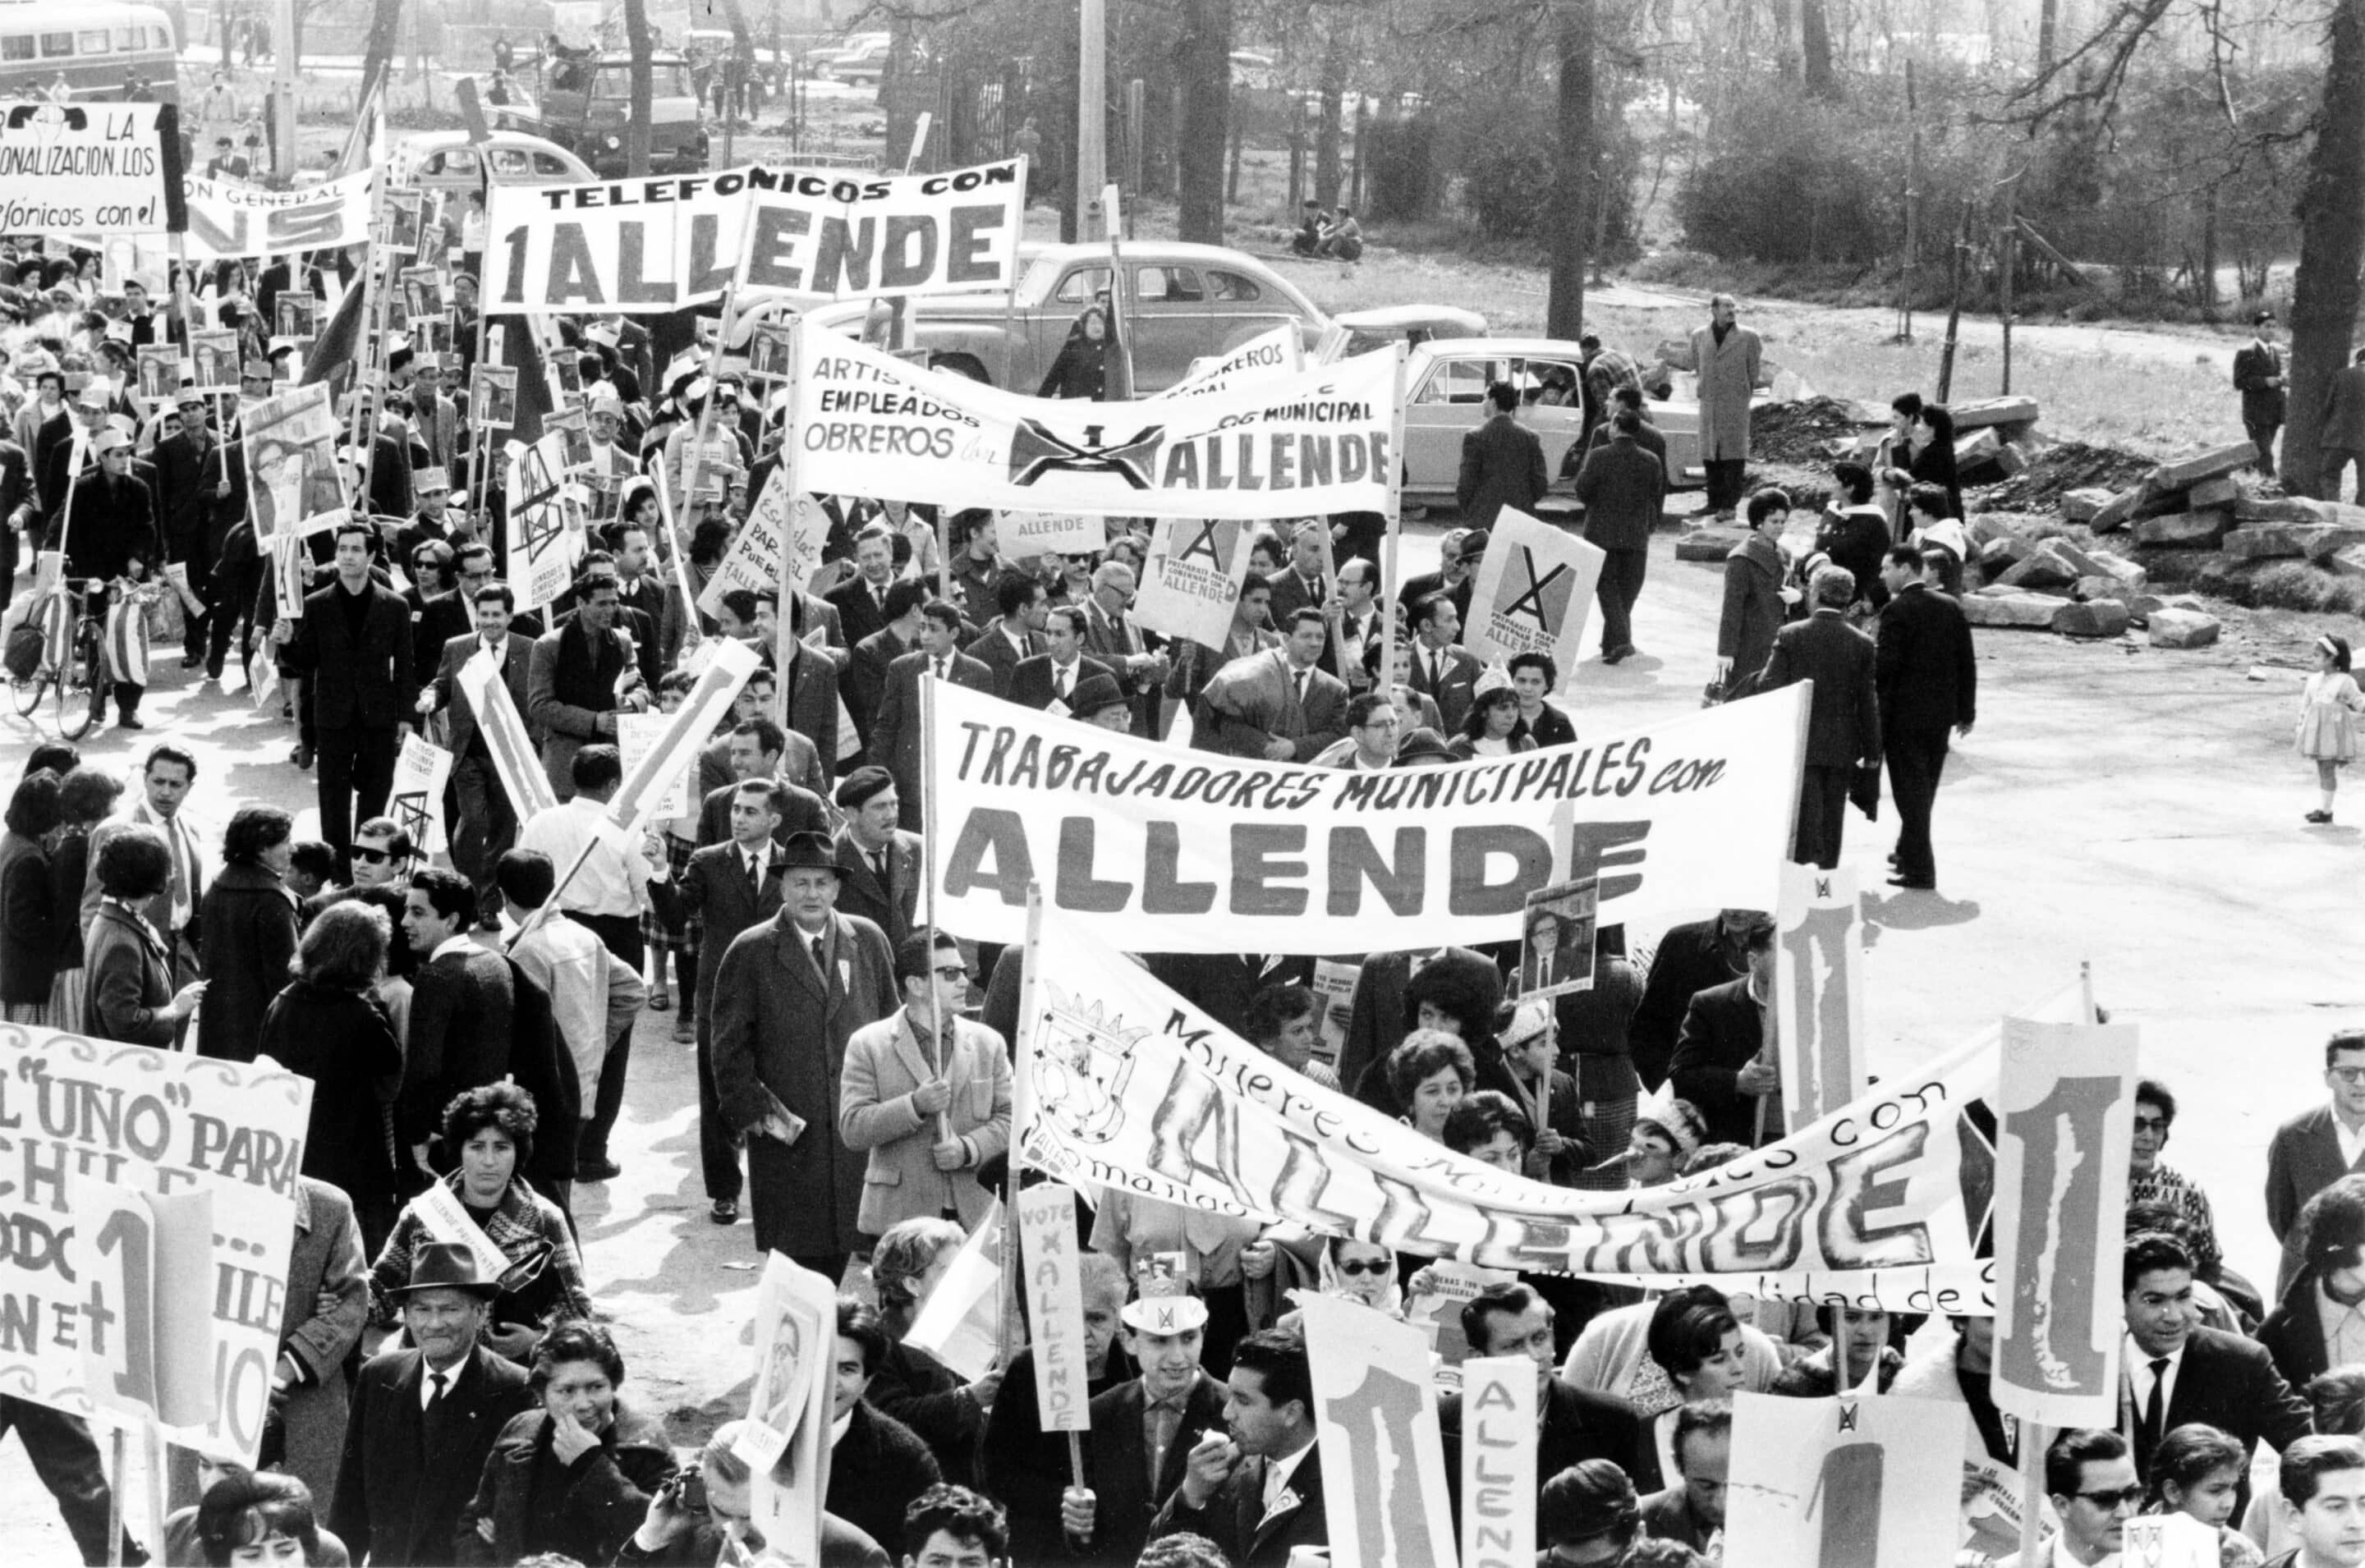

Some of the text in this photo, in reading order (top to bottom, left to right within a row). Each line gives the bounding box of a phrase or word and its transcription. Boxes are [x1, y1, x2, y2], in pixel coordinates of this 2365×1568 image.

[106, 112, 134, 141] LA
[123, 147, 154, 177] LOS
[541, 164, 1017, 211] TELEFONICOS CON
[0, 195, 156, 233] fónicos con el
[544, 204, 1006, 305] ALLENDE
[821, 389, 980, 428] EMPLEADOS
[1262, 401, 1375, 423] MUNICIPAL
[804, 422, 955, 459] OBREROS
[1162, 430, 1389, 491] ALLENDE
[749, 522, 781, 561] PAR
[1018, 517, 1085, 537] ALLENDE
[738, 540, 780, 585] PUEBL
[1163, 576, 1224, 604] ALLENDE
[958, 722, 1728, 812] TRABAJADORES MUNICIPALES con
[943, 806, 1652, 917] ALLENDE
[1830, 1080, 1946, 1146] con
[187, 1112, 301, 1199] PARA
[1148, 1055, 1935, 1273] ALLENDE
[1022, 1203, 1073, 1226] VOTE
[1040, 1231, 1062, 1254] X
[1908, 1267, 1964, 1313] de
[1036, 1259, 1075, 1431] ALLENDE
